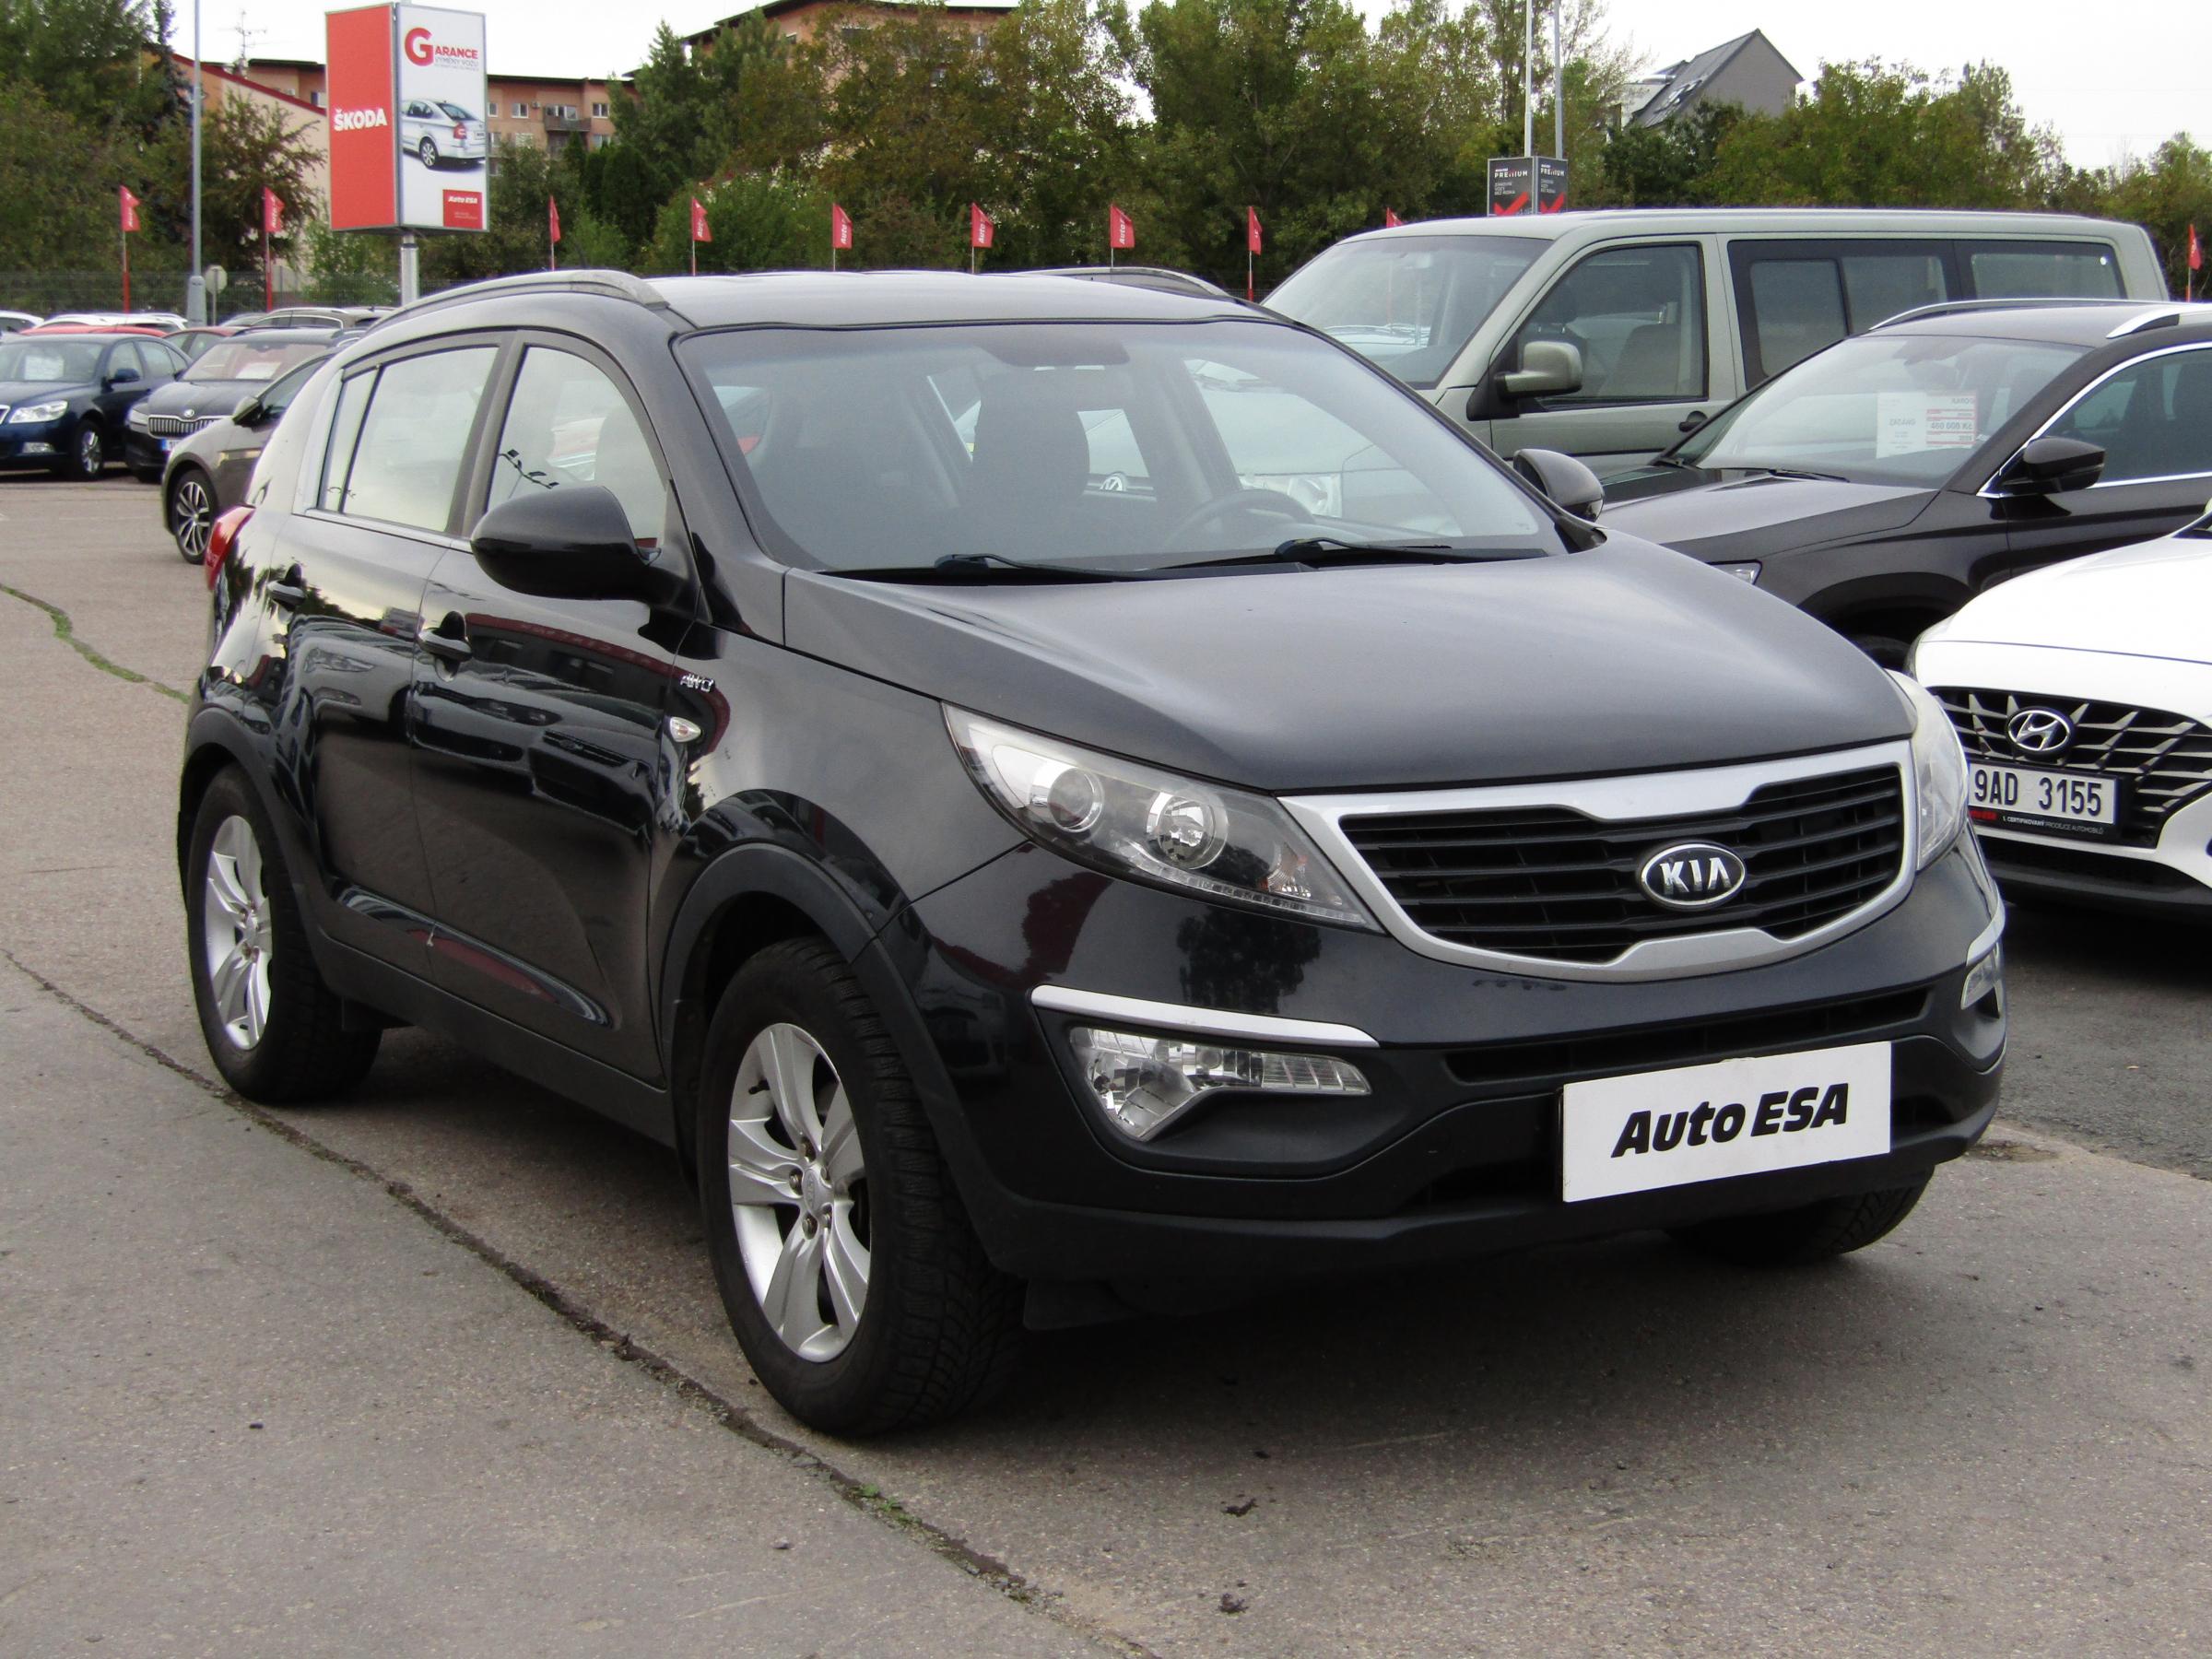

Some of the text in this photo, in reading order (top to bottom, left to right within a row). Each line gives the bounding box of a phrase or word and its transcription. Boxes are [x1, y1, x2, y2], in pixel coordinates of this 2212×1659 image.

[334, 108, 387, 131] ŠKODA
[1974, 769, 2102, 817] 9AD 3155
[1660, 857, 1733, 894] KIA
[1610, 1082, 1849, 1159] Auto ESA
